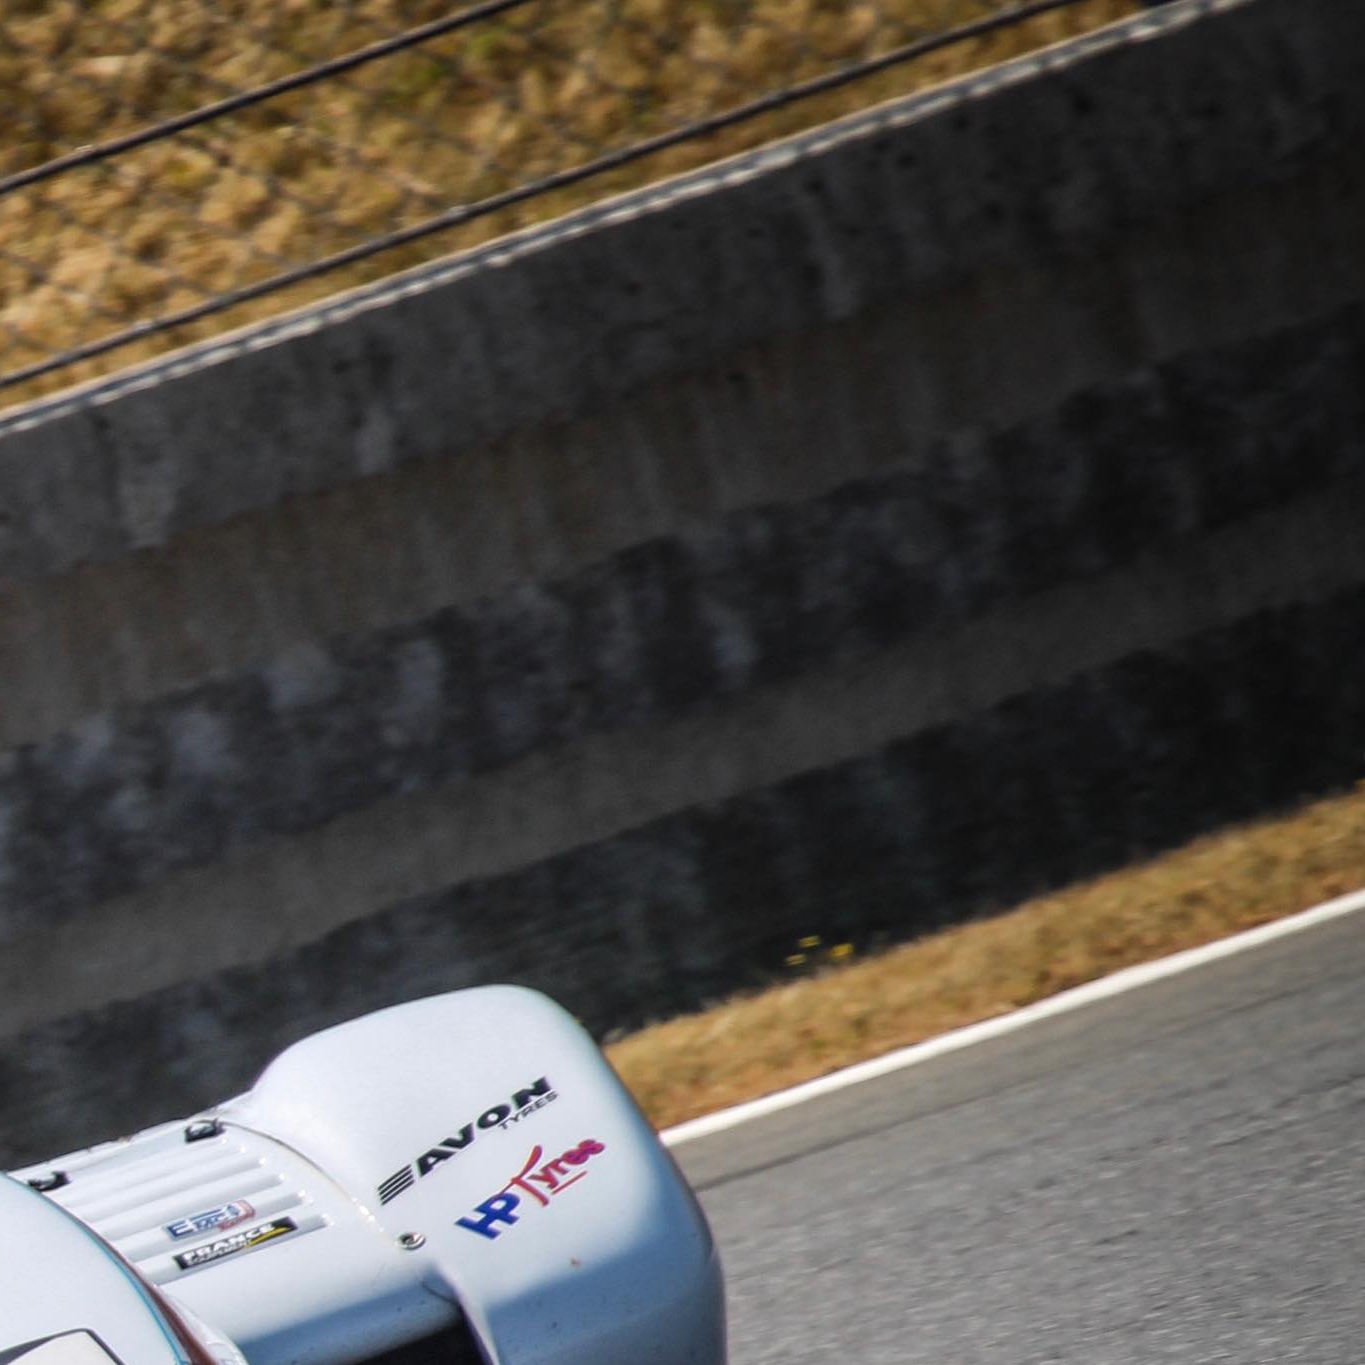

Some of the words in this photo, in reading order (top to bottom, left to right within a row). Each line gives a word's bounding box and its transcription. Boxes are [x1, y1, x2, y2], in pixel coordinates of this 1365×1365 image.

[416, 1076, 552, 1178] AVON
[498, 1089, 559, 1131] TYRES
[453, 1192, 521, 1240] HP
[182, 1221, 276, 1262] FRANCE
